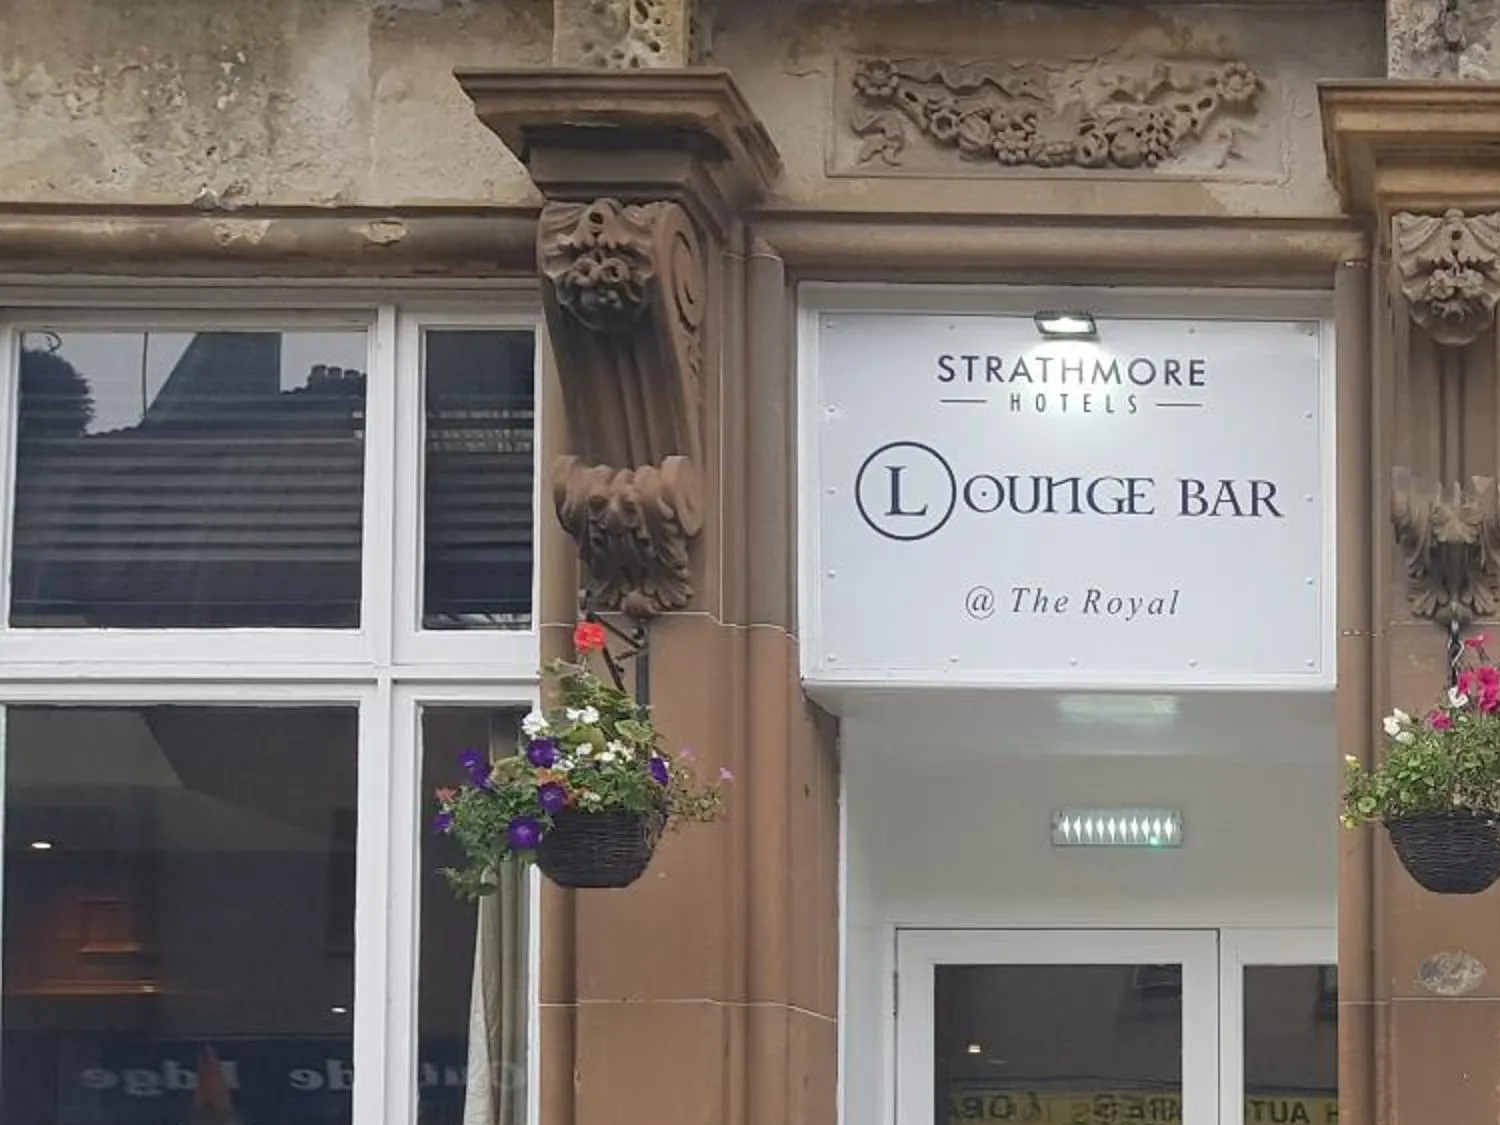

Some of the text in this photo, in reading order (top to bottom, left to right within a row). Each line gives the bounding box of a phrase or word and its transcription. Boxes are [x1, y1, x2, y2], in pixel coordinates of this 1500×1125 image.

[937, 354, 1206, 387] STRATHMORE
[1009, 393, 1138, 414] HOTELS
[1178, 478, 1285, 518] BAR
[964, 585, 1180, 621] @ The Royal
